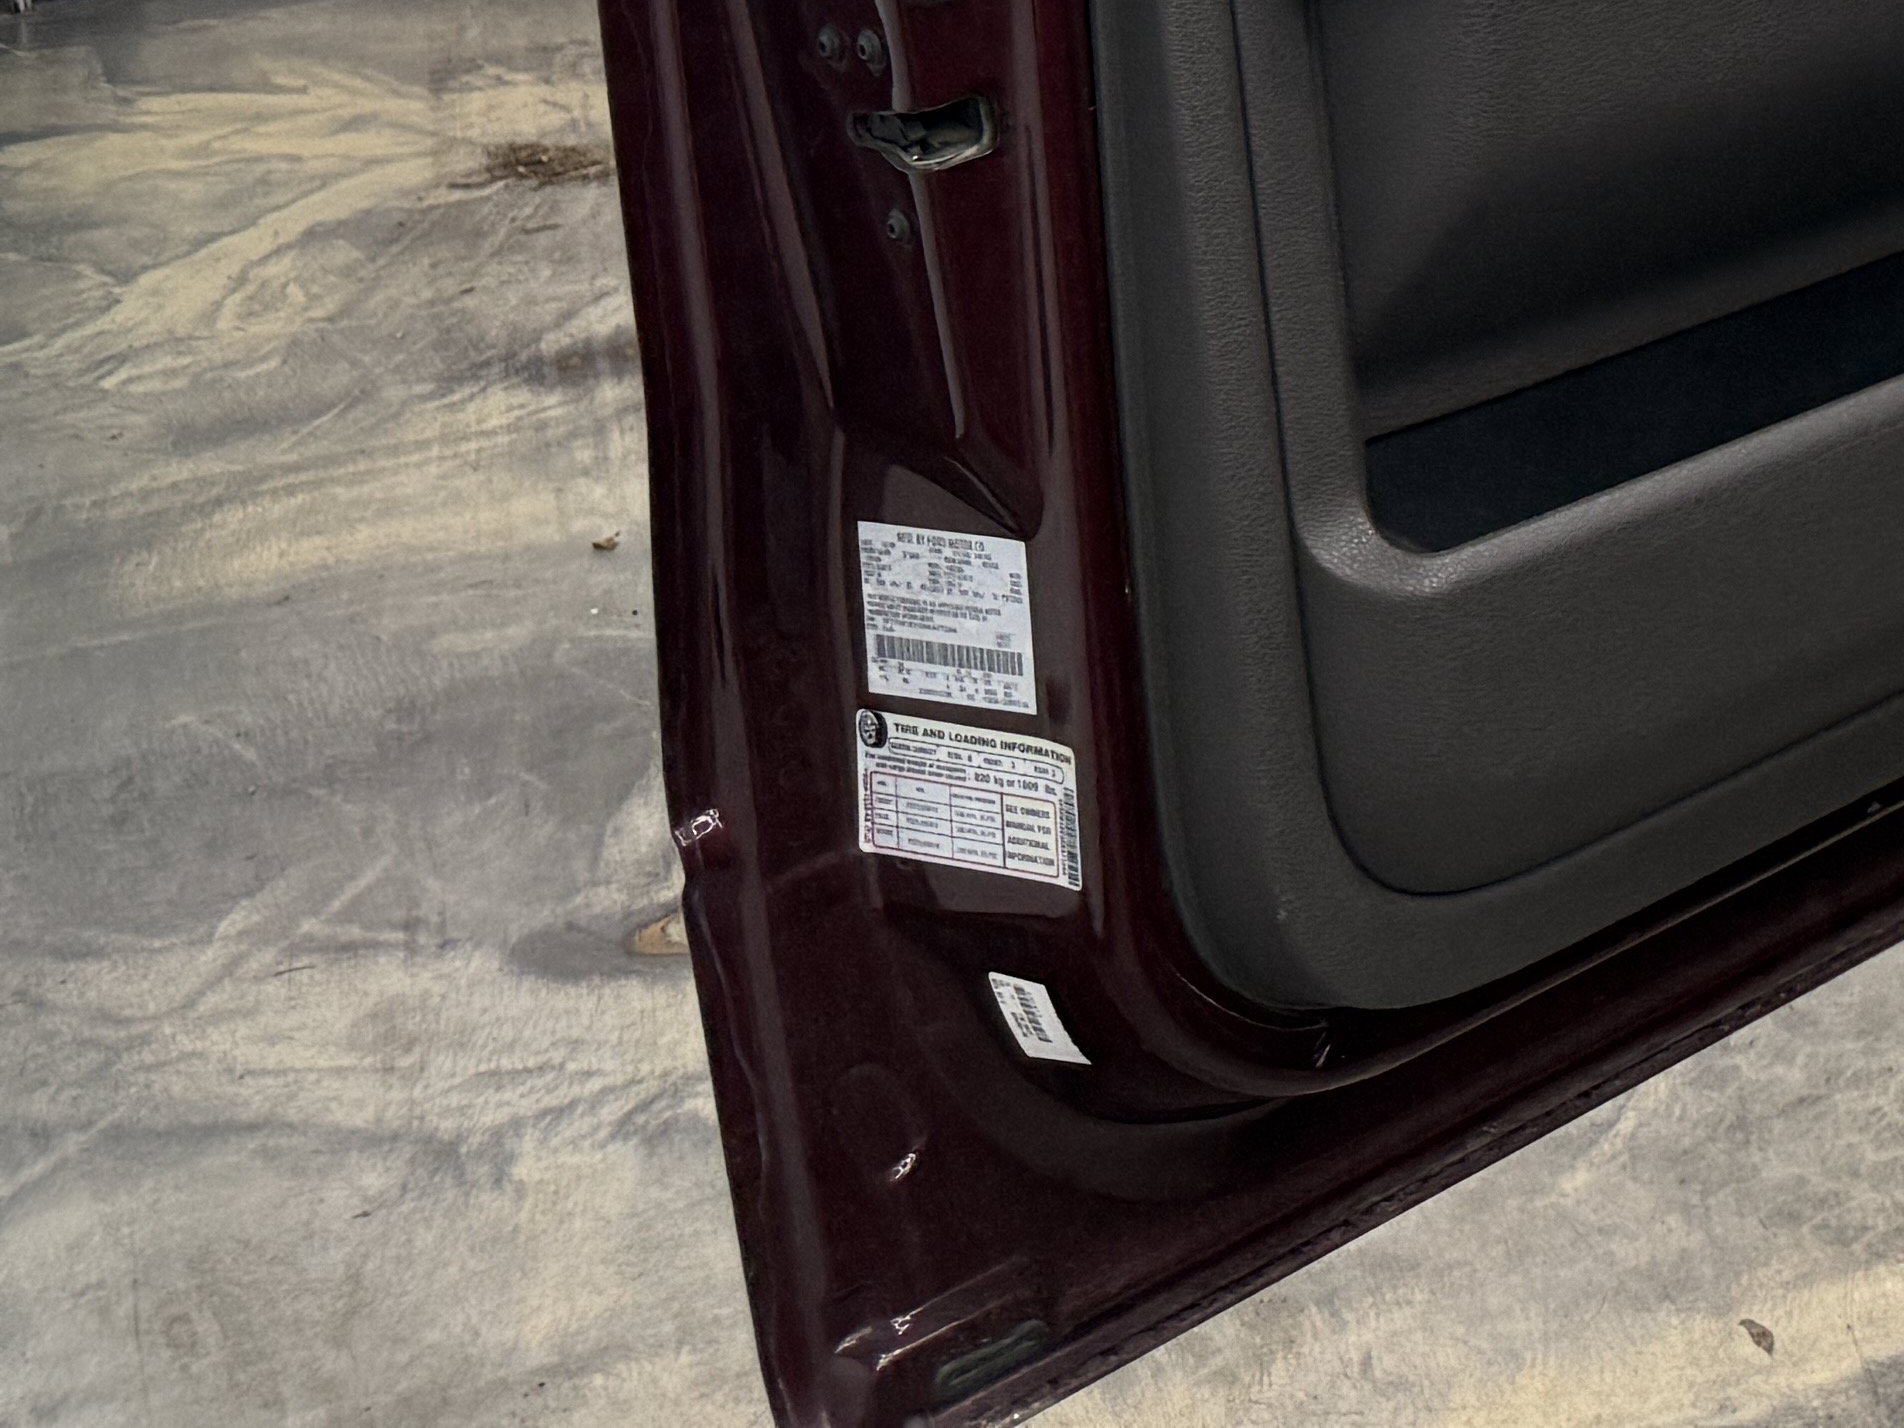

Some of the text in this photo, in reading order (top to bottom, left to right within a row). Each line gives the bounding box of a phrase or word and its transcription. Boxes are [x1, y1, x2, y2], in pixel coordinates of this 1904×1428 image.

[893, 723, 919, 736] TIRE
[922, 728, 945, 740] AND
[949, 731, 997, 749] LOADING
[1000, 740, 1072, 765] INFORMATION
